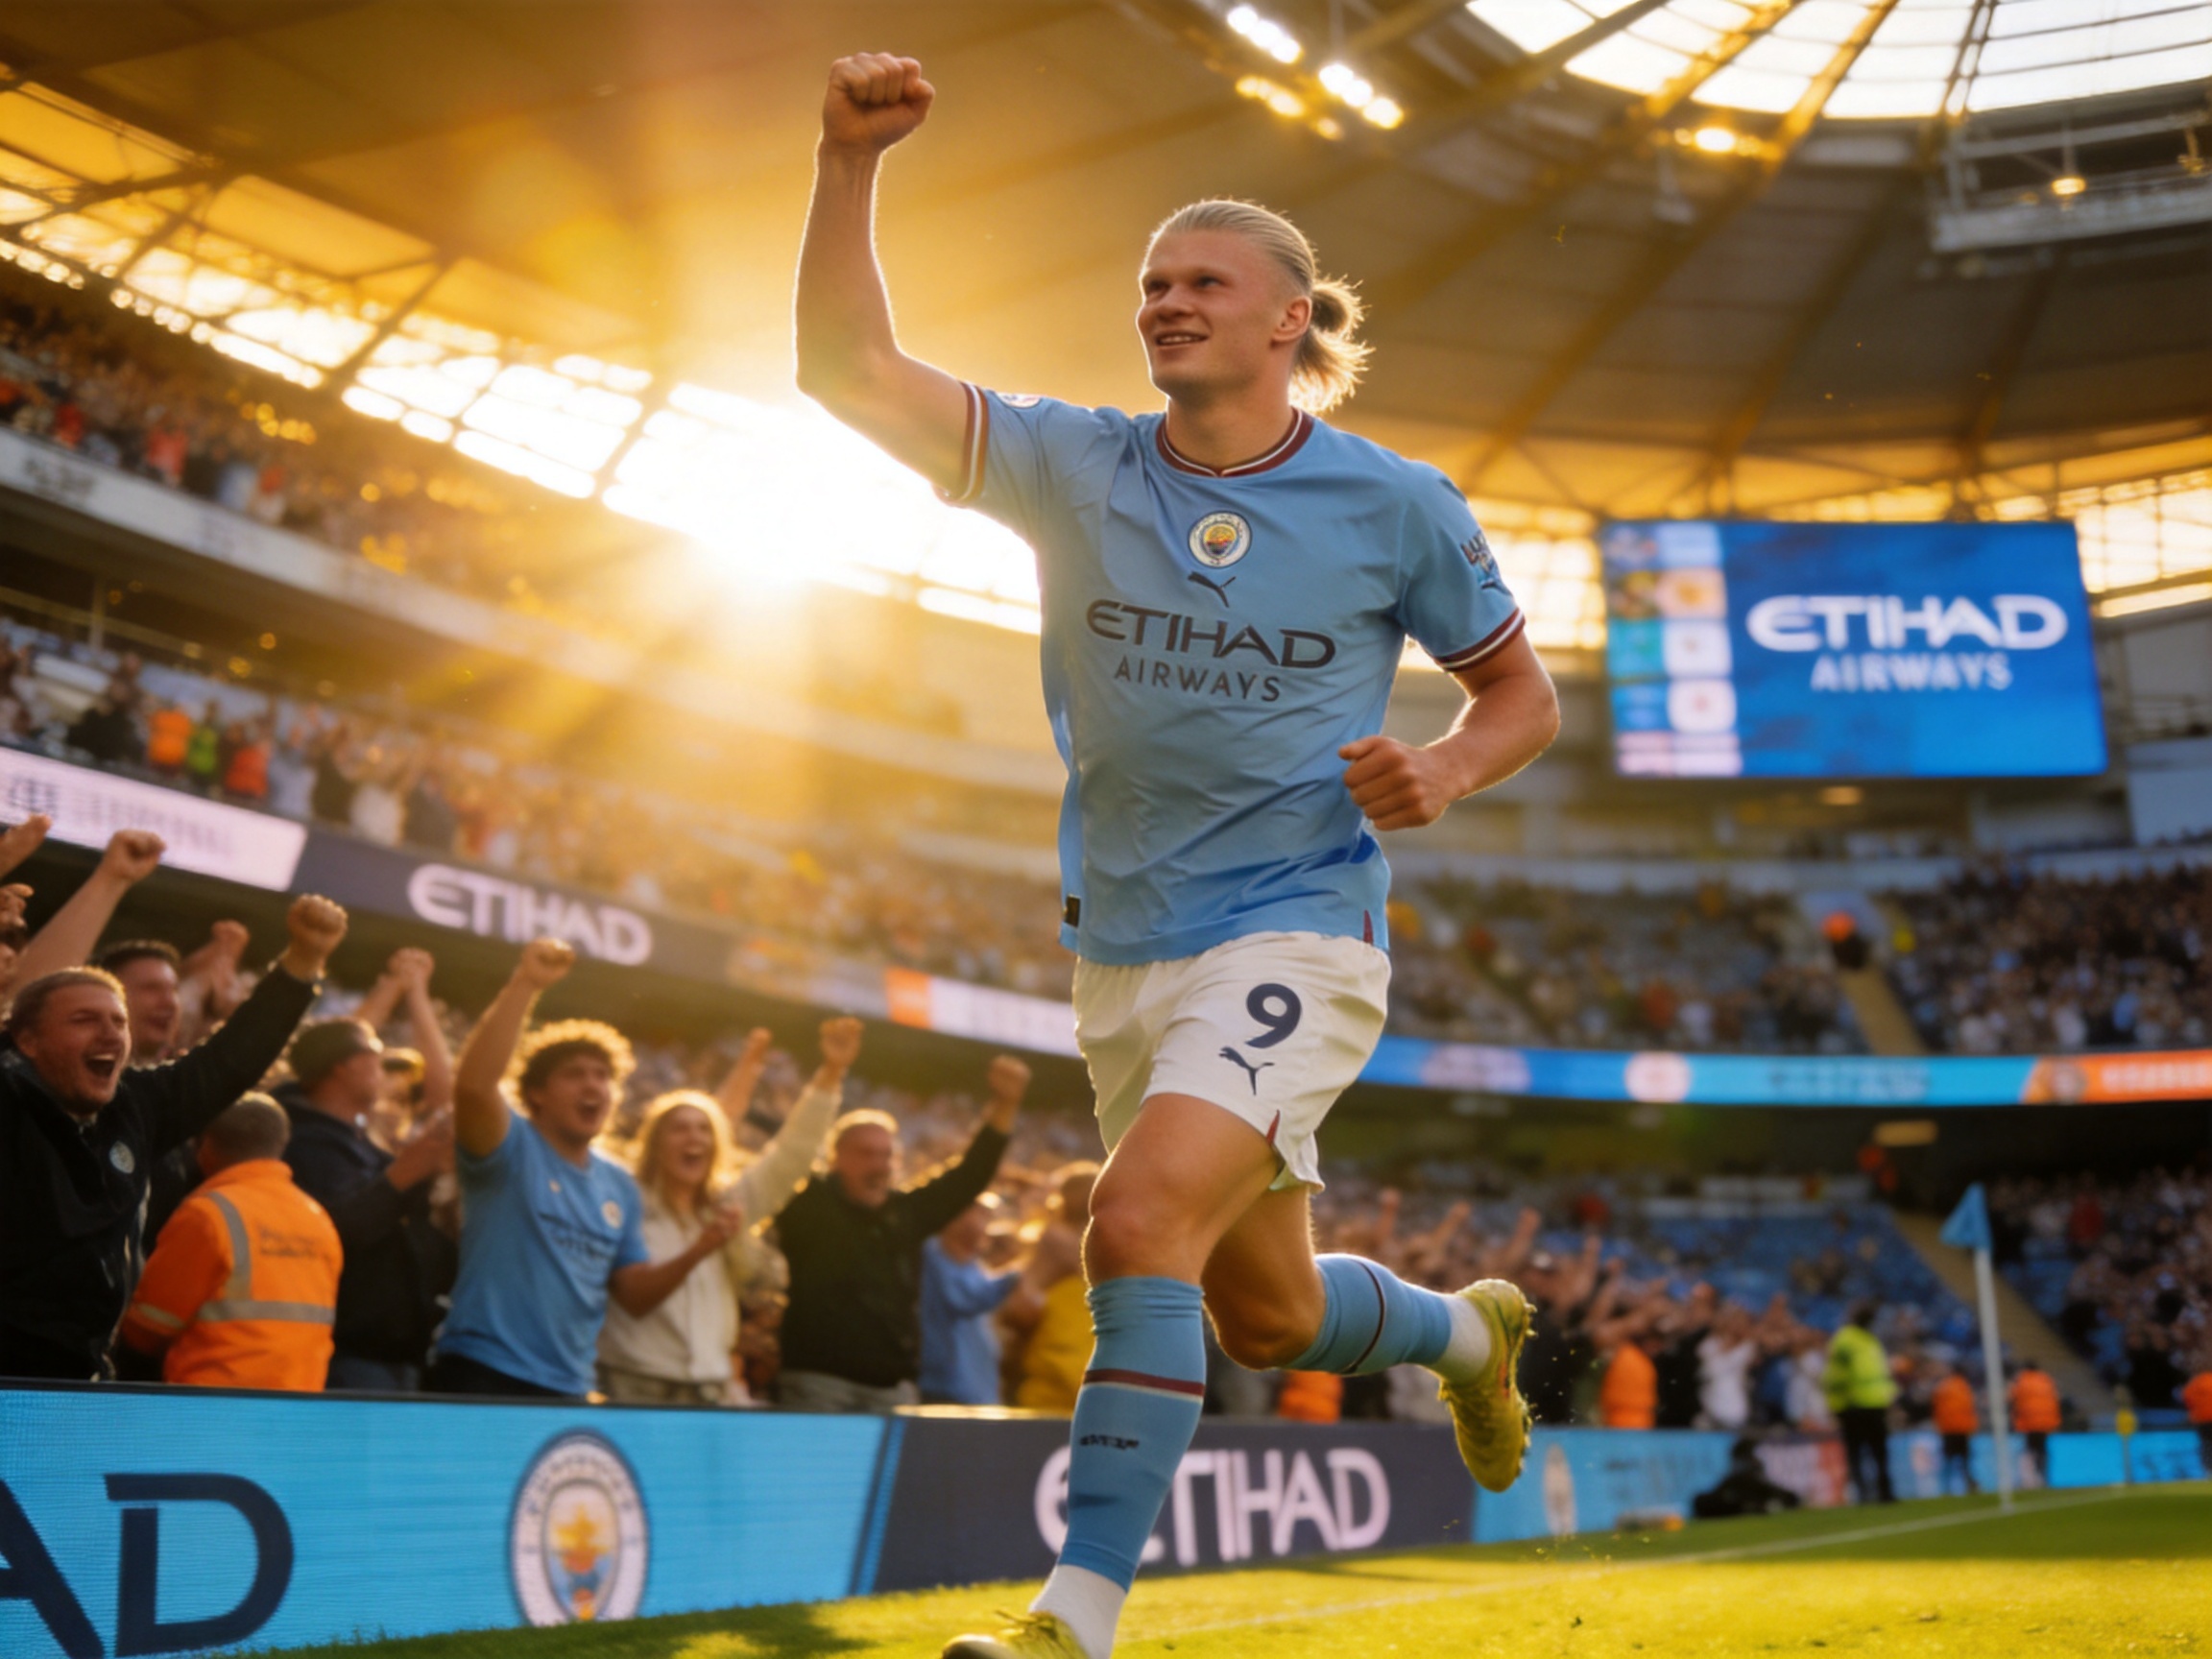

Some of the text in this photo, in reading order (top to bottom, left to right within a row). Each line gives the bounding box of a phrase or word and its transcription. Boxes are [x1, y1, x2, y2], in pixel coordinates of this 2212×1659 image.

[1087, 599, 1336, 669] ETIHAD
[1745, 594, 2069, 653] ETIHAD
[1114, 656, 1280, 702] AIRWAYS
[1810, 652, 2013, 692] AIRWAYS
[407, 862, 653, 967] ETIHAD
[1245, 983, 1302, 1049] 9
